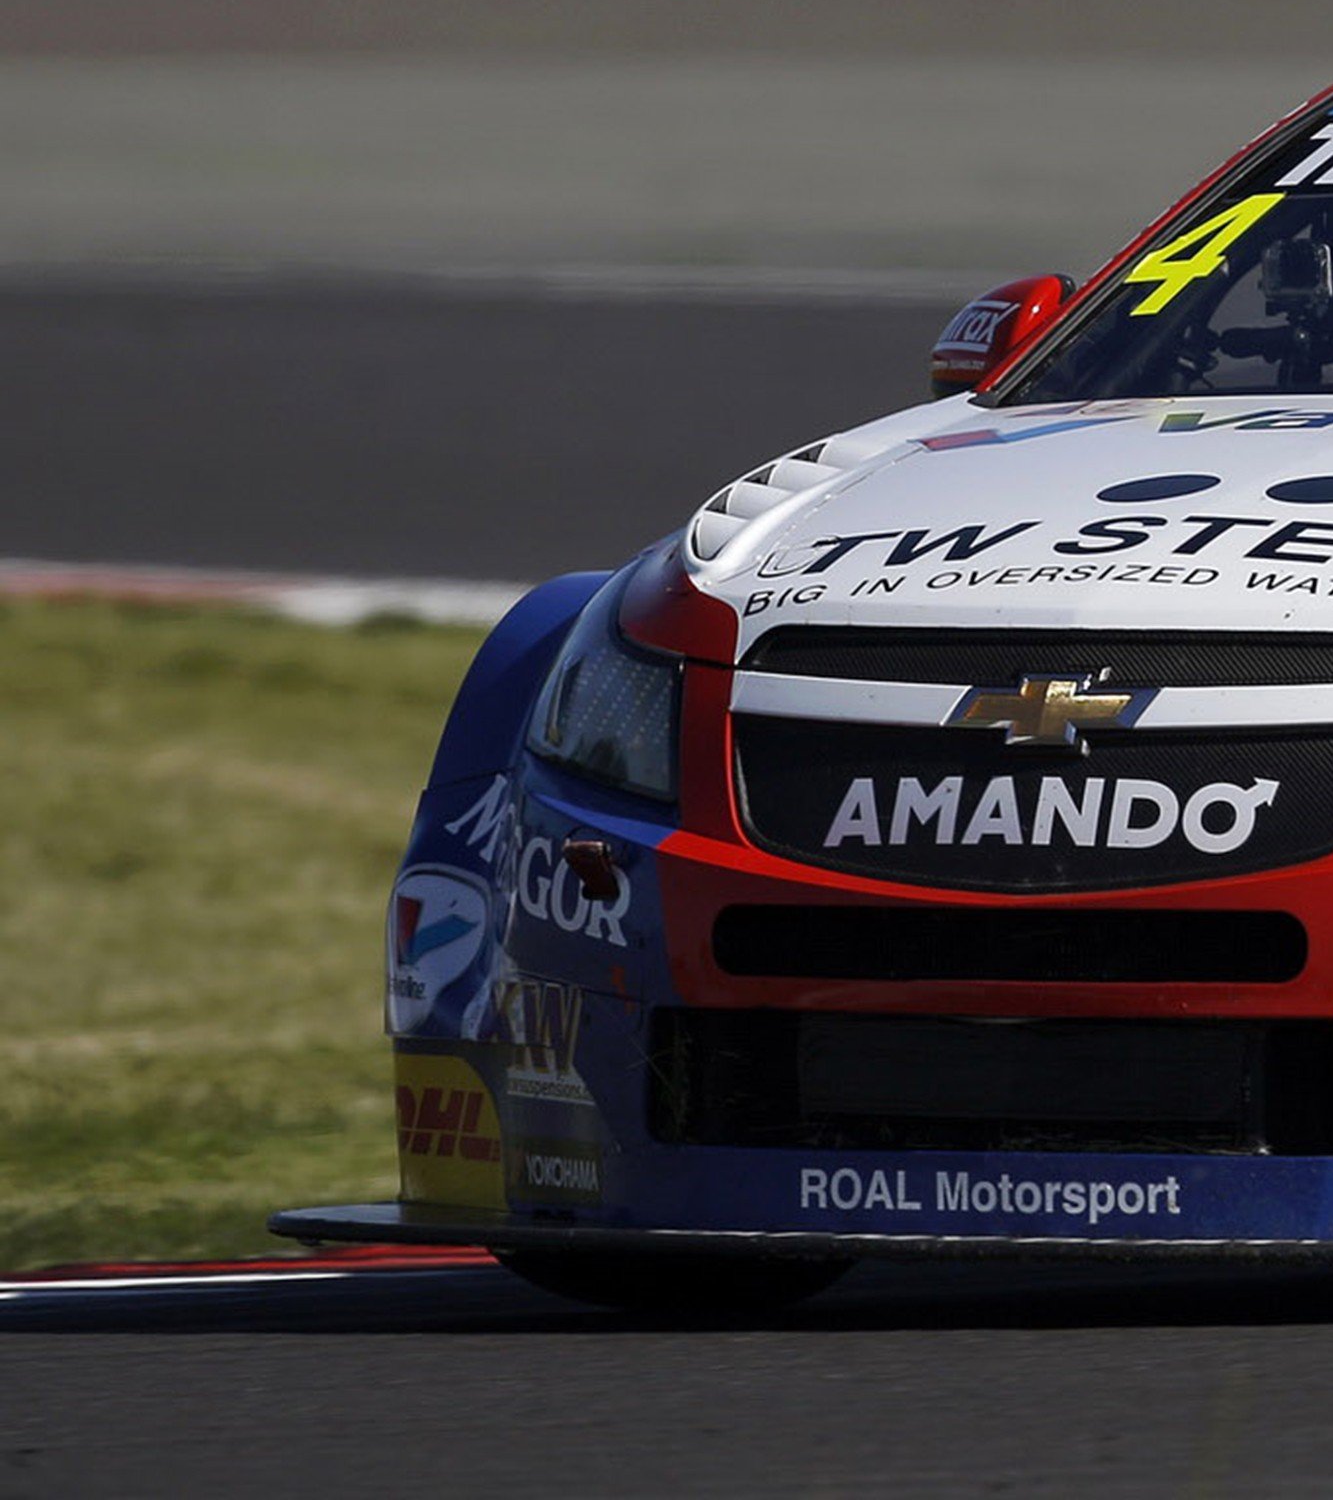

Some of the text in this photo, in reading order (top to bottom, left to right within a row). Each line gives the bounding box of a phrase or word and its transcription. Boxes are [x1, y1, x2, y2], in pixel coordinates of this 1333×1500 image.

[1124, 191, 1287, 316] 4
[802, 521, 1043, 575] TW
[743, 584, 828, 617] BIG
[851, 576, 906, 597] IN
[926, 564, 1219, 589] OVERSIZED
[823, 775, 1280, 854] AMANDO
[801, 1168, 1181, 1224] ROAL Motorsport
